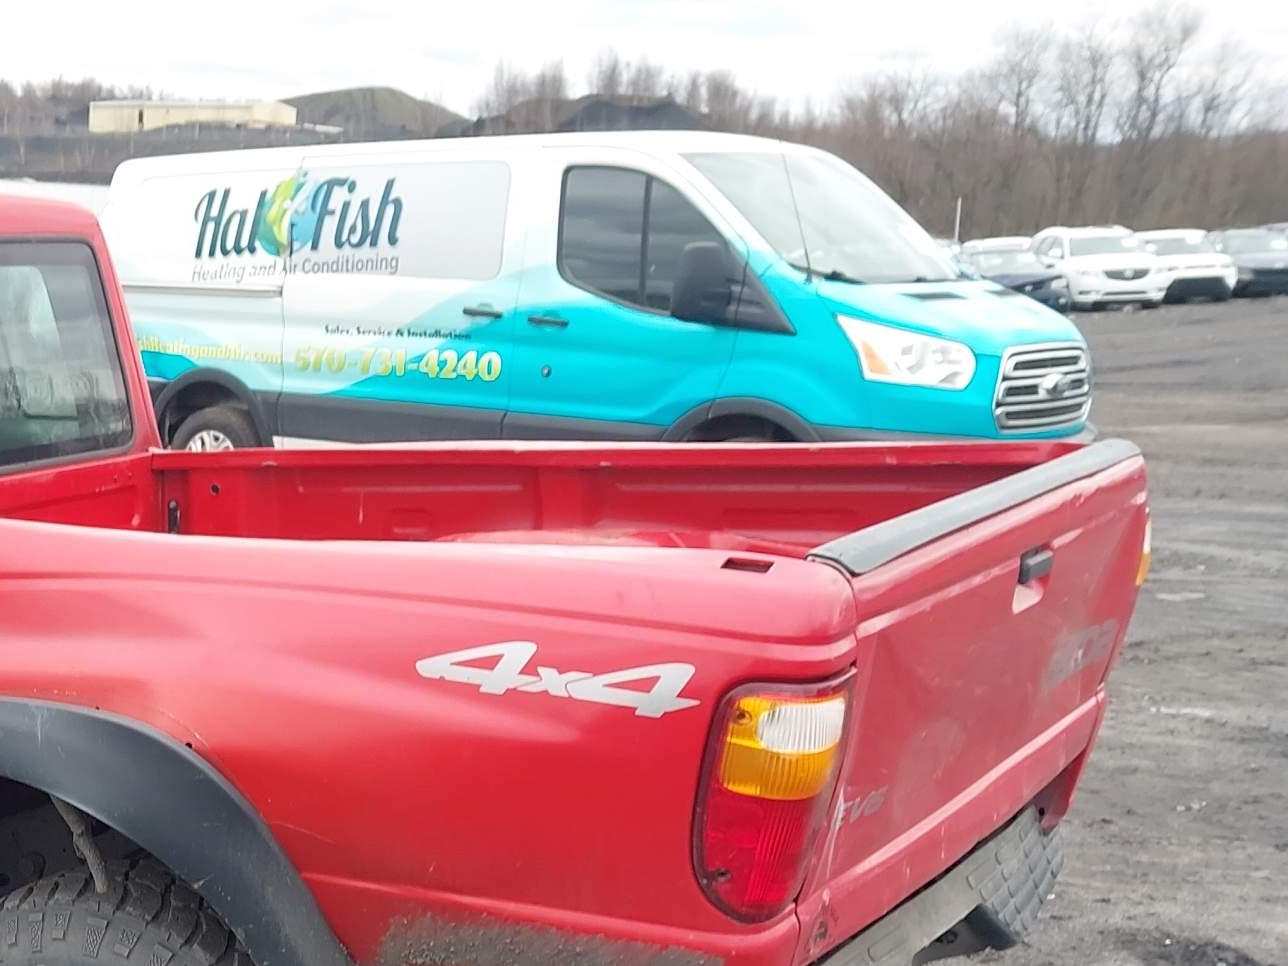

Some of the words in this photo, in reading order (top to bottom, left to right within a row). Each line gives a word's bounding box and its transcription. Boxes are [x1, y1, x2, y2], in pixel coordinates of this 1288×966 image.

[193, 188, 268, 259] Hal
[311, 176, 405, 252] Fish
[191, 263, 246, 283] Heating
[248, 262, 277, 277] and
[282, 258, 298, 275] Air
[302, 255, 400, 275] Conditioning
[356, 326, 392, 337] Service
[395, 328, 405, 337] &
[407, 328, 472, 340] Installation
[295, 345, 503, 381] 570-731-4240
[415, 640, 701, 718] 4x4
